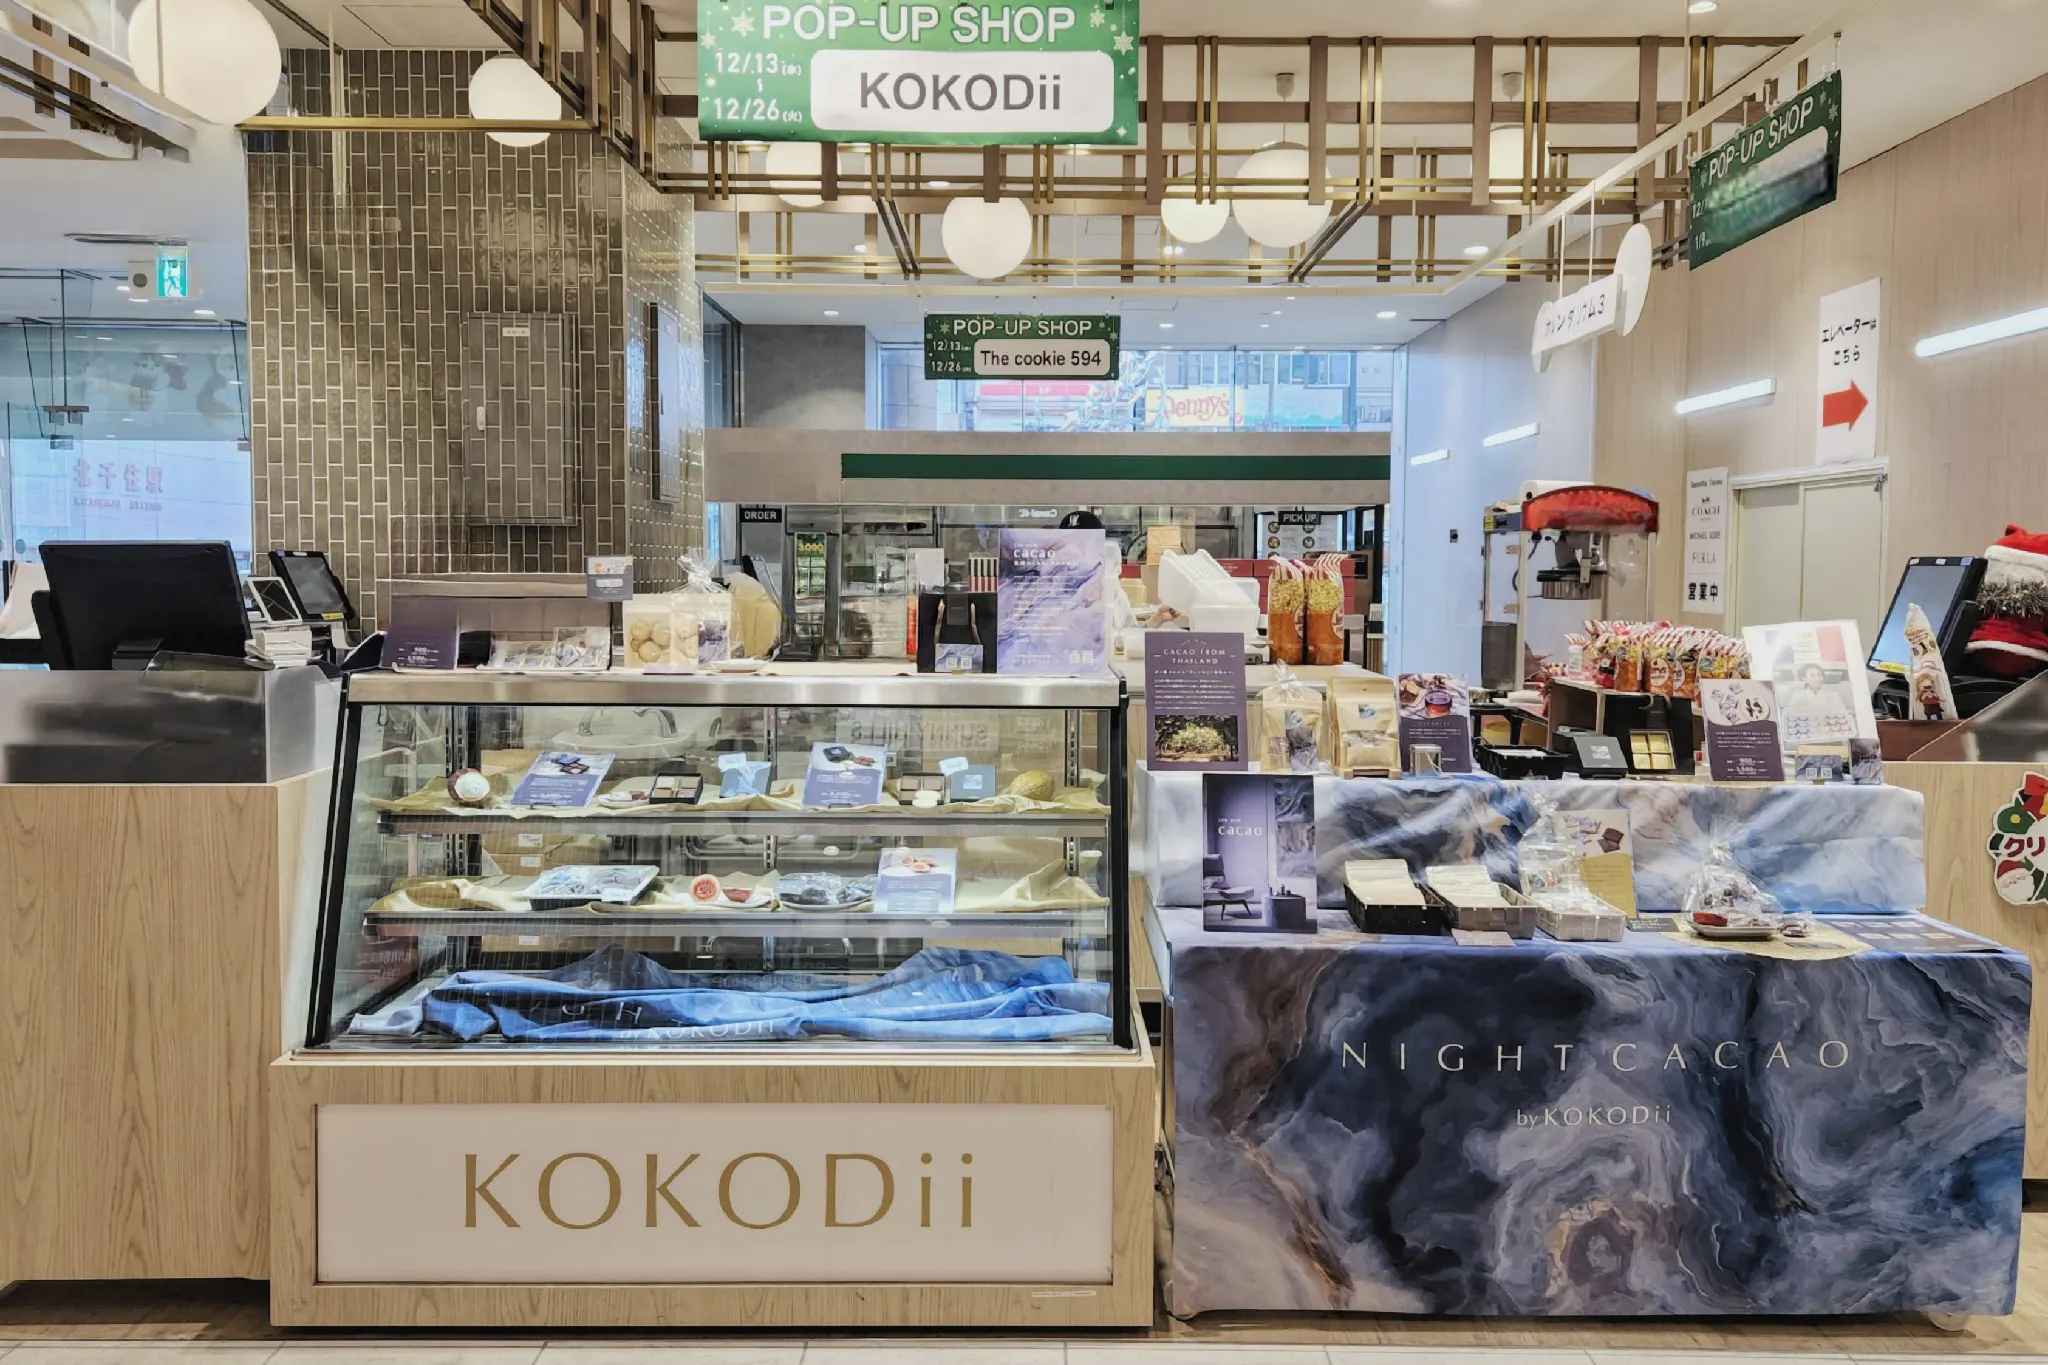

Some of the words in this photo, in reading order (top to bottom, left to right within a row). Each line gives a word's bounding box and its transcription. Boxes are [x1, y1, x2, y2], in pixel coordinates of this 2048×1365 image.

[762, 4, 941, 43] POP-UP
[951, 6, 1077, 44] SHOP
[859, 72, 1062, 111] KOKODii
[1708, 128, 1765, 186] POP-UP
[1767, 96, 1815, 150] SHOP
[953, 319, 1032, 336] POP-UP
[1037, 320, 1093, 336] SHOP
[980, 350, 1010, 367] The
[1014, 350, 1066, 367] cookie
[1070, 350, 1102, 367] 594
[1833, 345, 1861, 366] こちら
[744, 511, 778, 521] ORDER
[1283, 513, 1304, 523] PICK
[1304, 513, 1317, 523] UP
[1691, 551, 1717, 565] FURLA
[1688, 582, 1719, 602] 営業中
[1163, 648, 1196, 656] CACAO
[1200, 648, 1226, 656] FROM
[1341, 1041, 1575, 1072] NIGHT
[1611, 1040, 1850, 1071] CACAO
[1516, 1108, 1539, 1129] by
[1543, 1104, 1672, 1127] KOKODii
[464, 1152, 973, 1230] KOKODii
